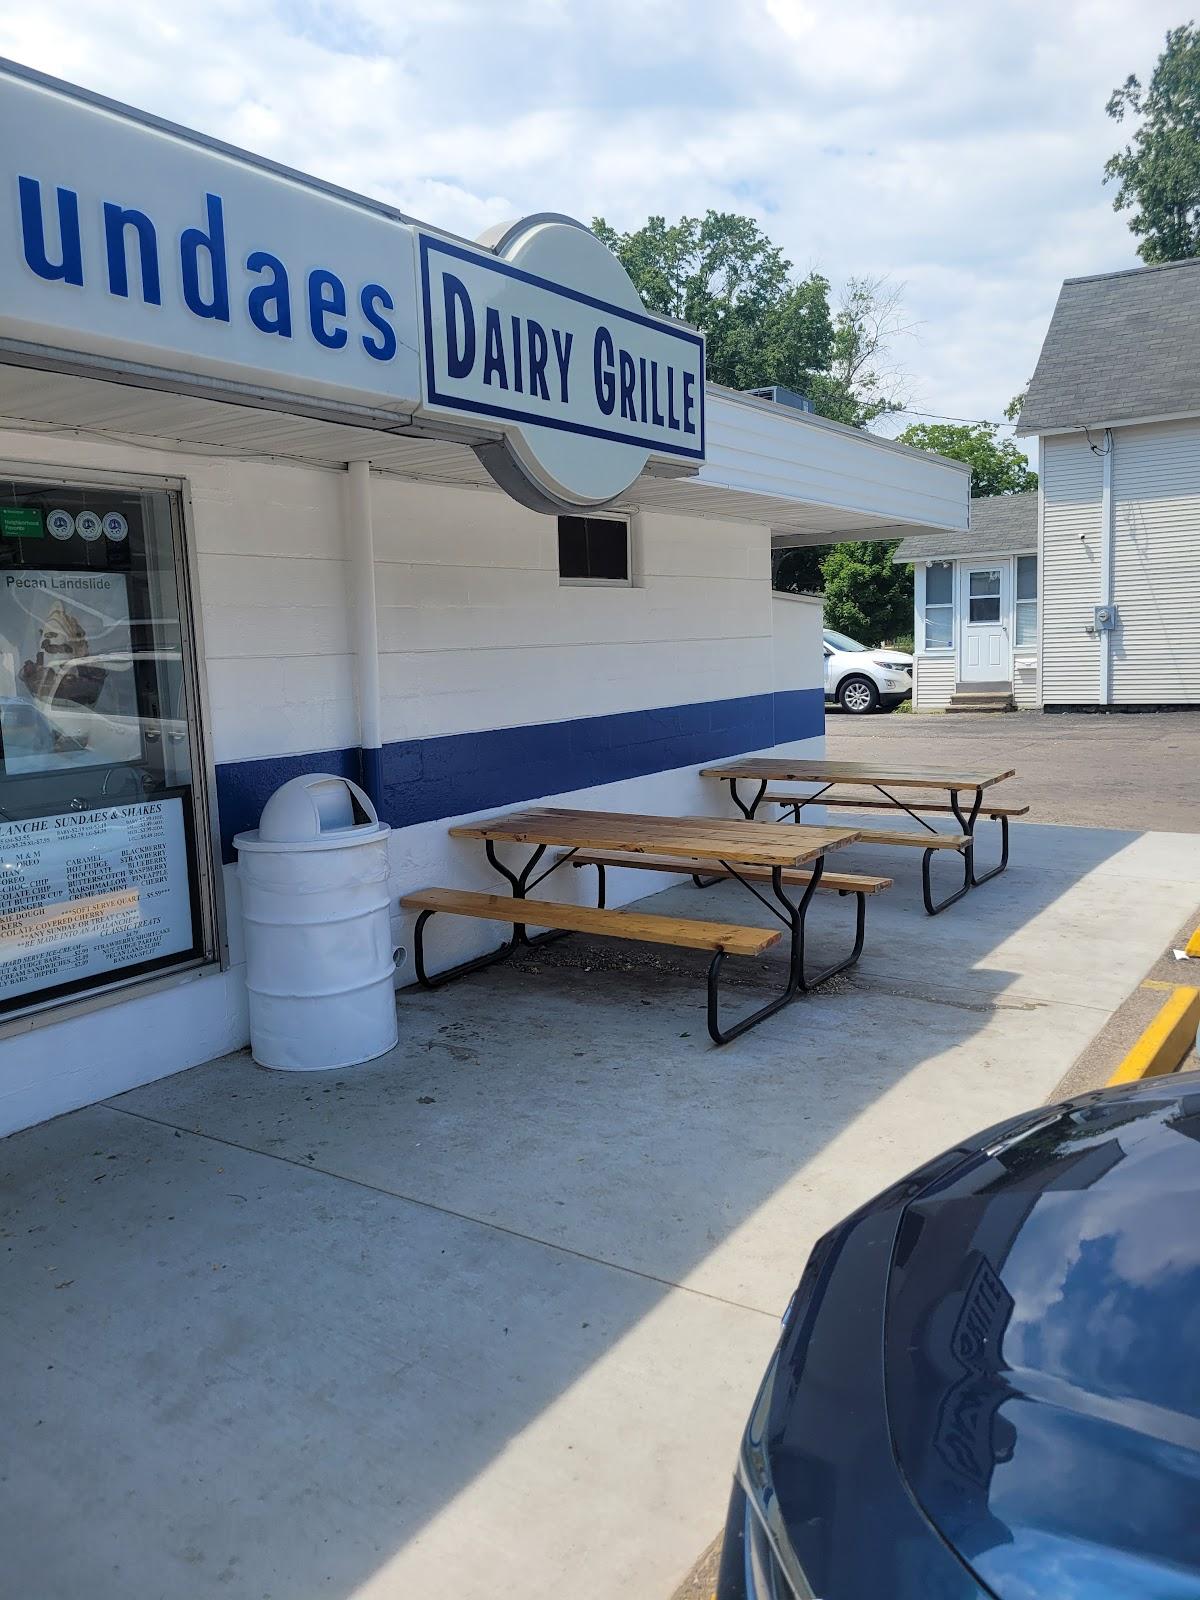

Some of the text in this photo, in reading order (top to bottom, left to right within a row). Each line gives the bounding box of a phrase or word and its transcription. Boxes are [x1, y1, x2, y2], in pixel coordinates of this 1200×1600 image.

[18, 174, 398, 362] undaes
[443, 272, 697, 434] DAIRY GRILLE
[6, 576, 112, 590] Pecan Landslide
[55, 811, 108, 829] SUNDAES
[111, 810, 119, 820] &
[122, 804, 163, 819] SHAKES
[120, 849, 167, 865] STRAWBERRY
[121, 843, 167, 858] BLACKBERRY
[66, 855, 103, 867] CARAMEL
[67, 860, 109, 873] HOT FUDGE
[127, 856, 168, 870] BLUEBERRY
[67, 866, 113, 881] CHOCOLATE
[129, 863, 168, 876] RASPBERRY
[132, 869, 169, 882] PINEAPPLE
[30, 879, 49, 888] CHIP
[68, 871, 127, 888] BUTTERSCOTCH
[69, 877, 128, 895] MARSHMALLOW
[140, 876, 168, 887] CHERRY
[32, 885, 51, 895] CHIP
[14, 894, 46, 906] BUTTER
[47, 890, 64, 899] CUP
[93, 900, 116, 911] SERVE
[116, 894, 141, 906] QUART
[16, 908, 46, 921] DOUGH
[36, 917, 73, 931] COVERED
[74, 911, 104, 924] CHERRY
[1, 920, 23, 930] KERS
[46, 921, 77, 935] SUNDAE
[79, 920, 89, 928] OR
[101, 917, 162, 938] CLASSIC TREATS
[37, 934, 60, 946] MADE
[94, 927, 171, 952] STRAWBERRY SHORTCAKE
[139, 935, 163, 947] PARFAIT
[23, 952, 45, 963] SERVE
[106, 950, 126, 960] PECAN
[19, 959, 43, 971] FUDGE
[1, 969, 26, 982] CREAM
[10, 975, 28, 985] BARS
